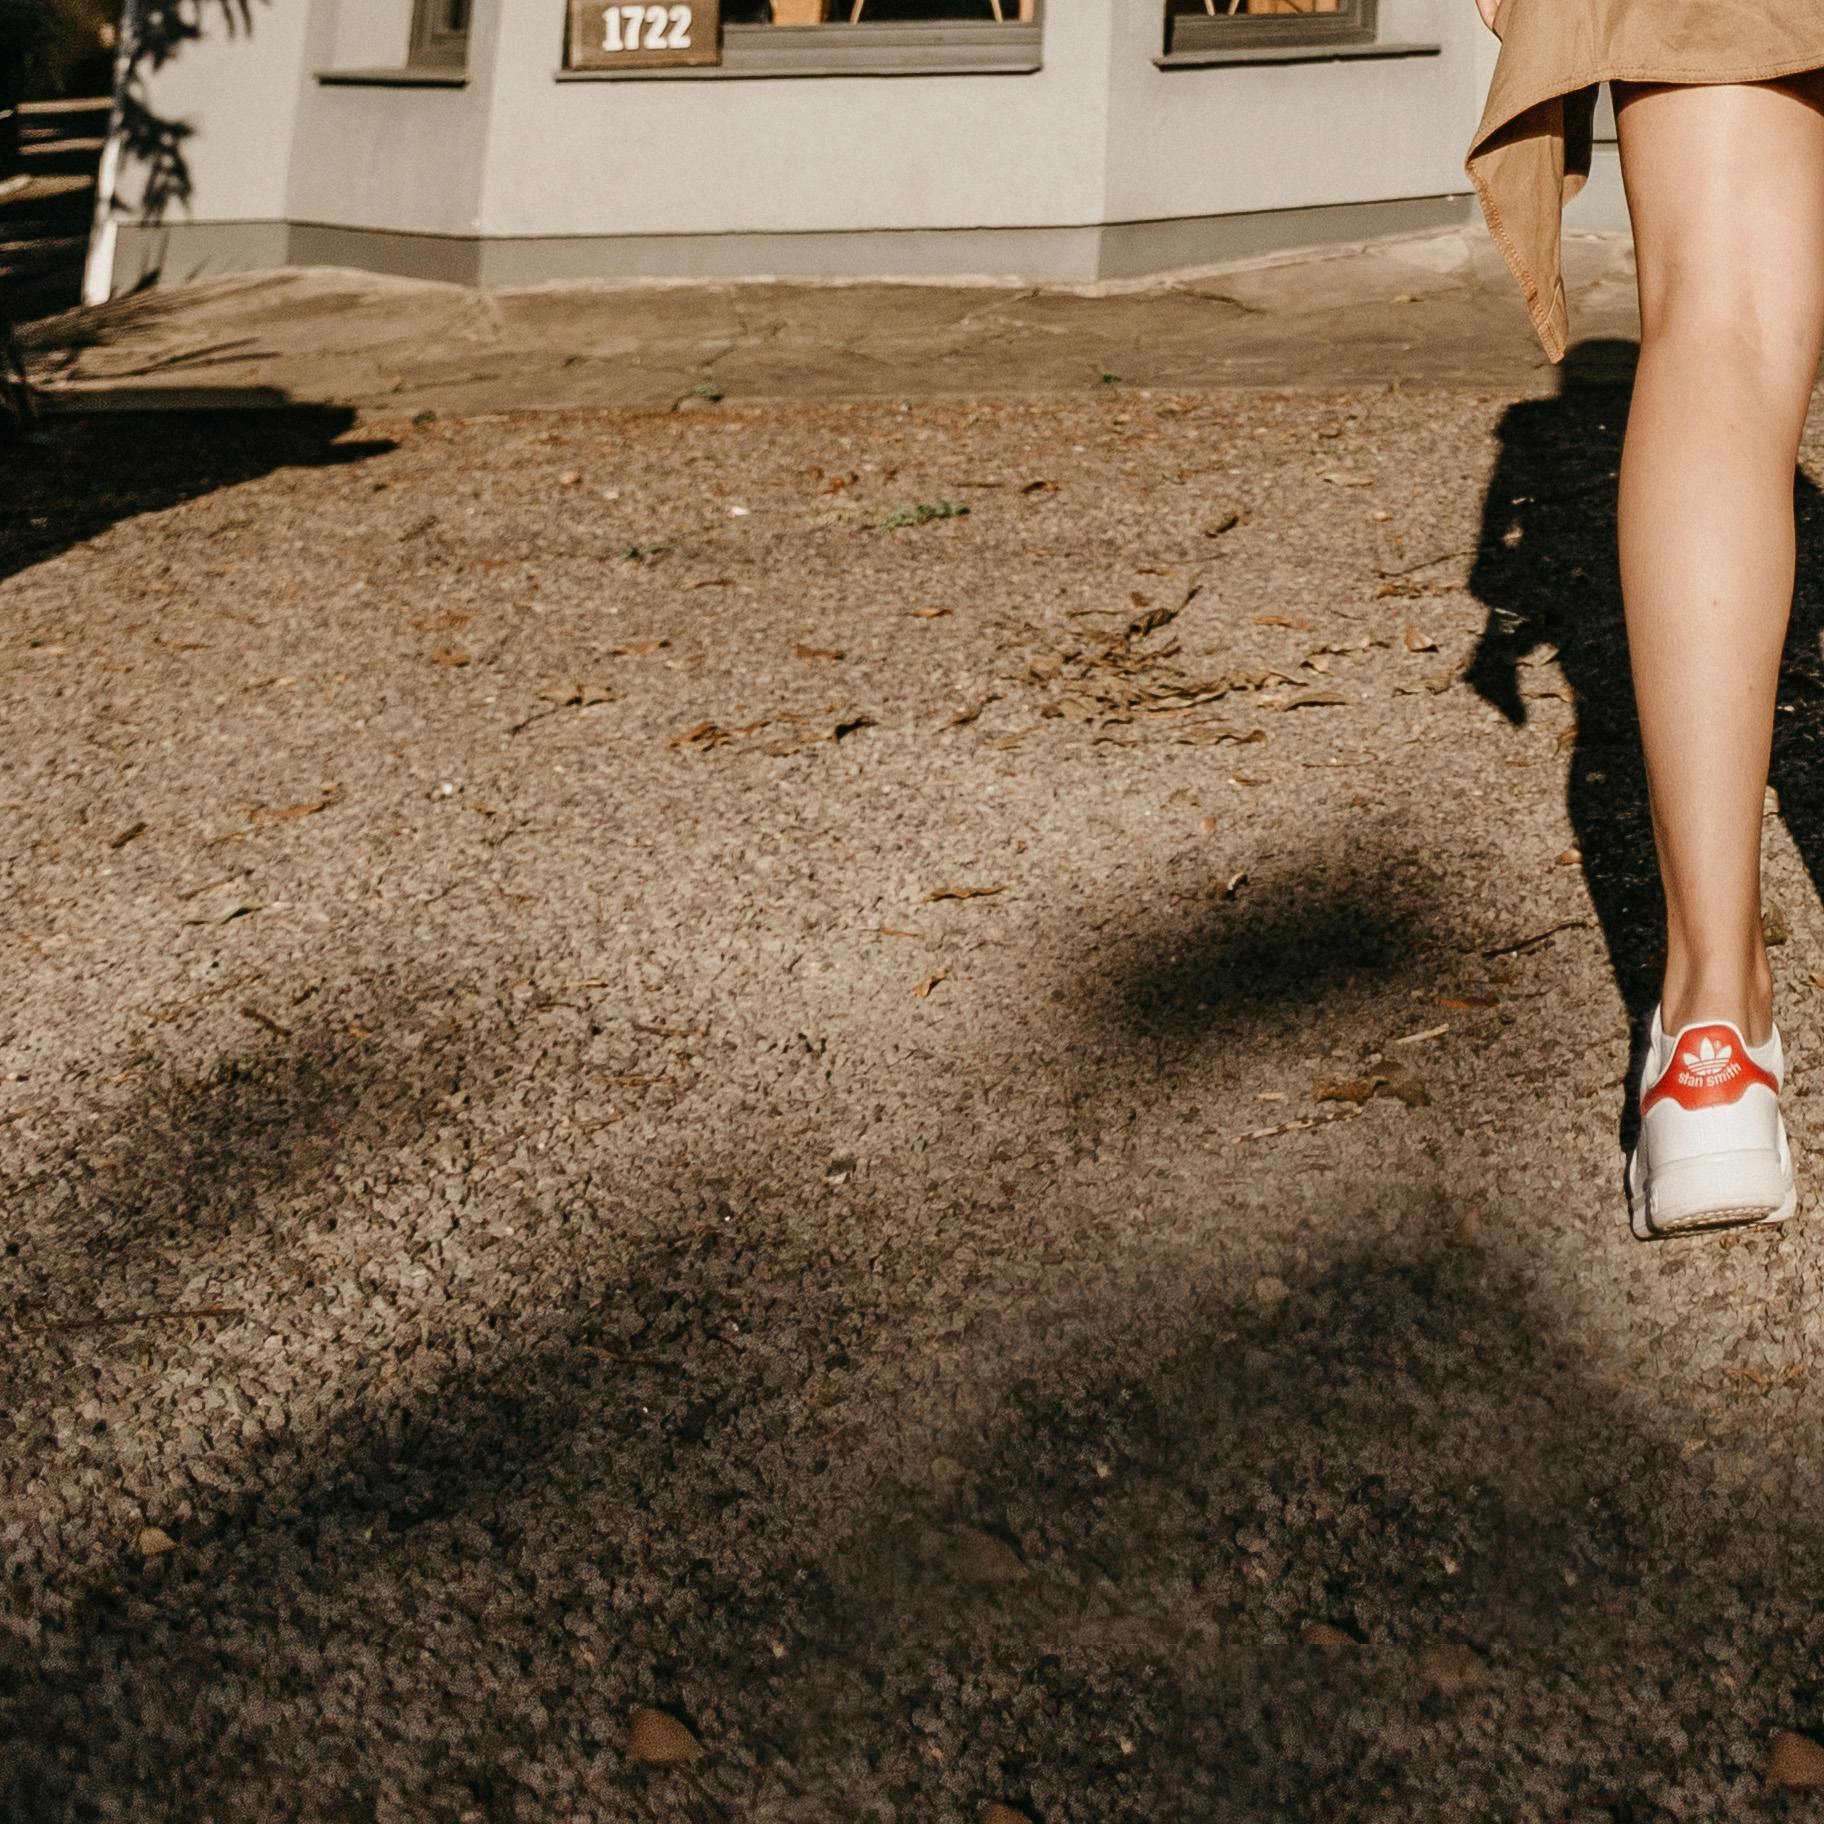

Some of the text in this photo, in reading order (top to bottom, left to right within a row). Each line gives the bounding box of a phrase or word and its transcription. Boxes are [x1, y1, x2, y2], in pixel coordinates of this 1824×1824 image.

[602, 5, 692, 51] 1722
[1678, 1062, 1742, 1087] stan smith
